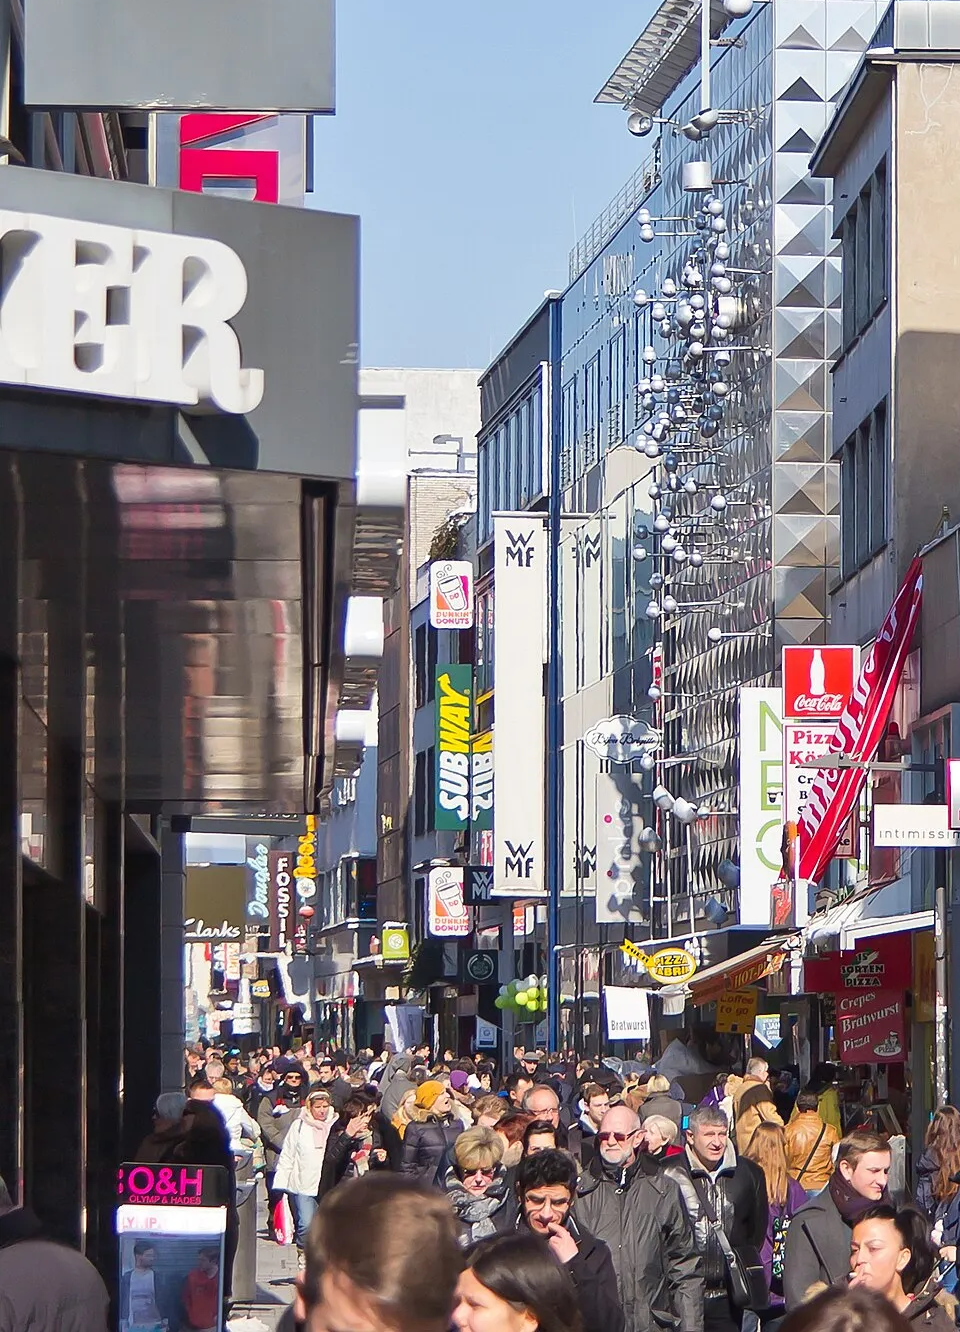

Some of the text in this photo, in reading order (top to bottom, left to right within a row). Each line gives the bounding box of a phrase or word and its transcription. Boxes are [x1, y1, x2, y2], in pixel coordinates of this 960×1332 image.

[793, 693, 842, 713] Coca-Cola
[437, 673, 471, 821] SUBWAY
[276, 856, 291, 948] FOSSIL
[655, 954, 688, 965] PIZZA
[841, 964, 884, 974] SORTEN
[845, 977, 881, 986] PIZZA
[720, 995, 754, 1005] Coffee
[840, 991, 876, 1010] Crepes
[611, 1020, 648, 1032] Bratwurst
[842, 1002, 899, 1034] Bratwurst
[843, 1034, 870, 1052] Pizza
[128, 1166, 203, 1196] O&H
[129, 1194, 202, 1206] OLYMP & HADES
